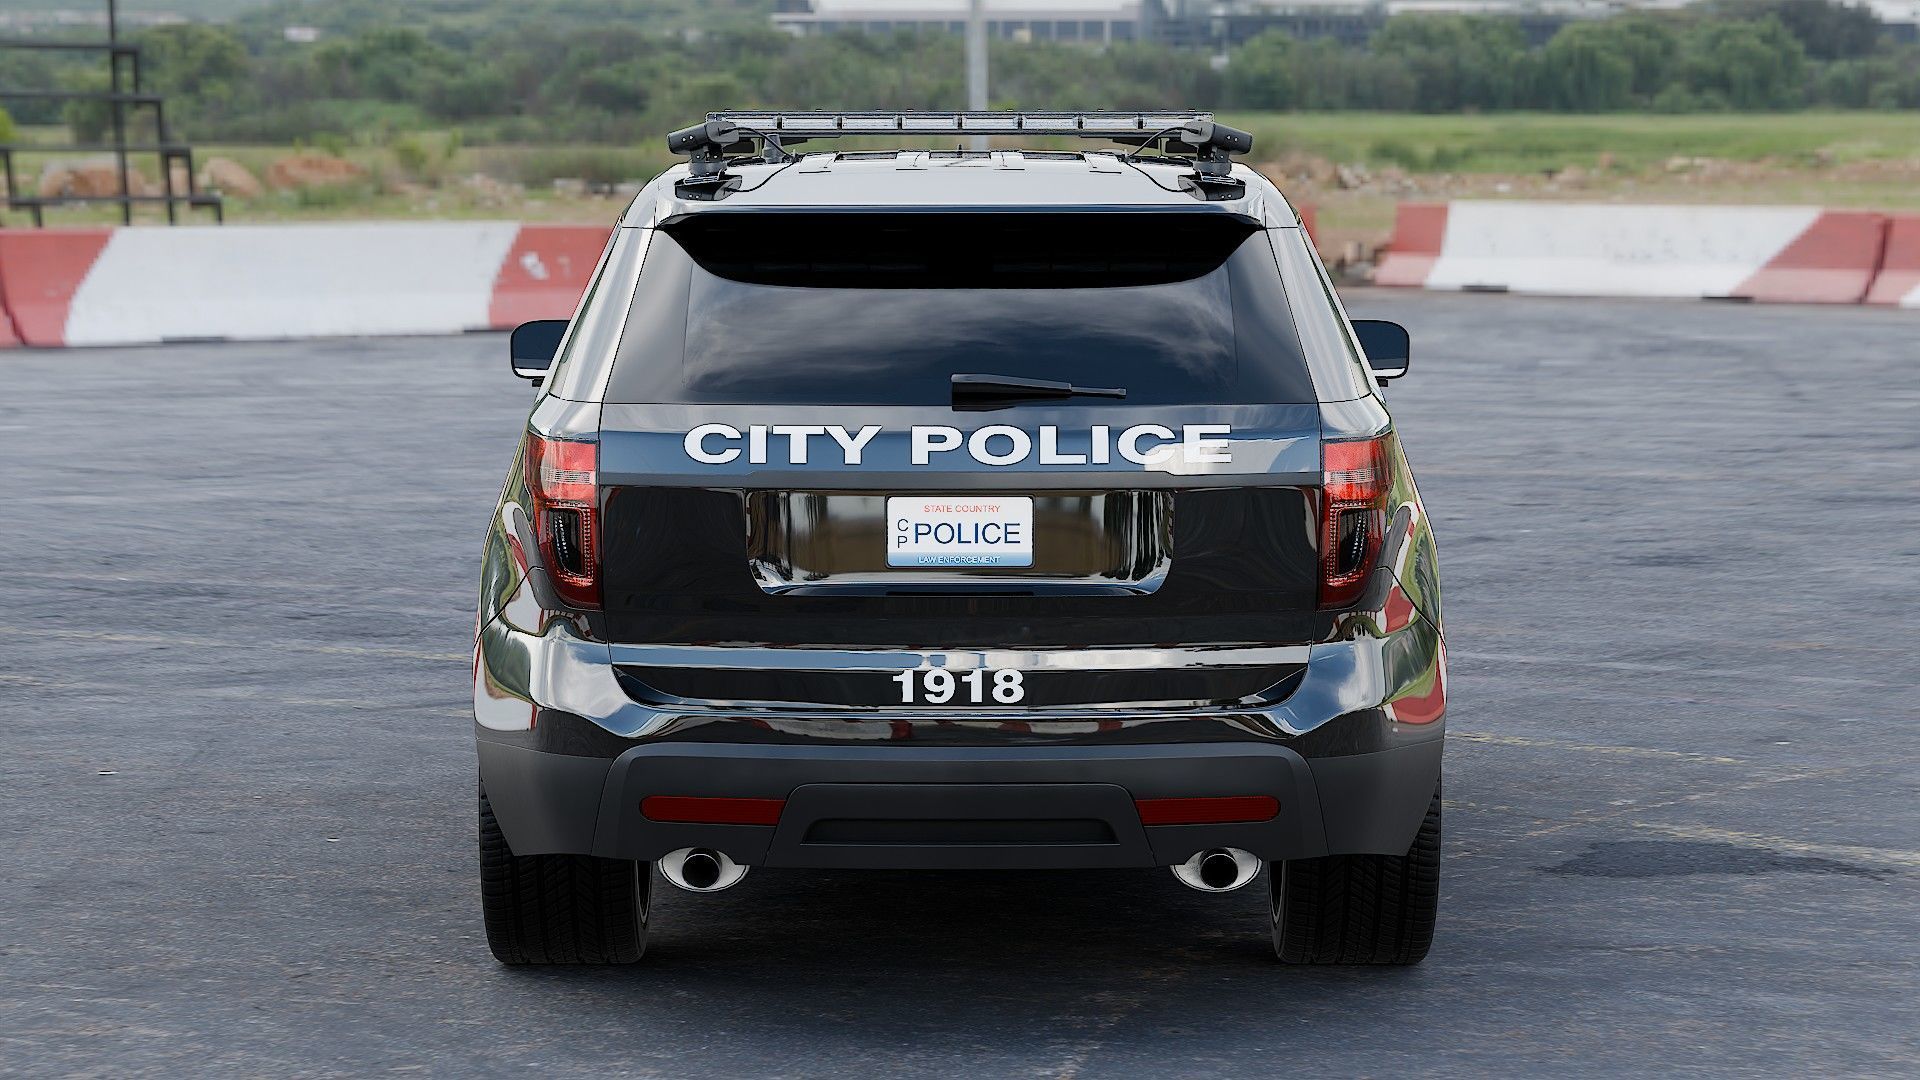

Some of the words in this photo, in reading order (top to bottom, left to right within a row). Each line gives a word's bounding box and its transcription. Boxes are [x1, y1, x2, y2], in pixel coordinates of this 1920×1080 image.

[682, 423, 882, 465] CITY
[911, 423, 1232, 466] POLICE
[924, 505, 952, 513] STATE
[955, 505, 1001, 513] COUNTRY
[914, 522, 1021, 545] POLICE
[918, 556, 937, 564] LAW
[938, 556, 1001, 564] ENFORCEMENT
[892, 668, 1025, 704] 1918
